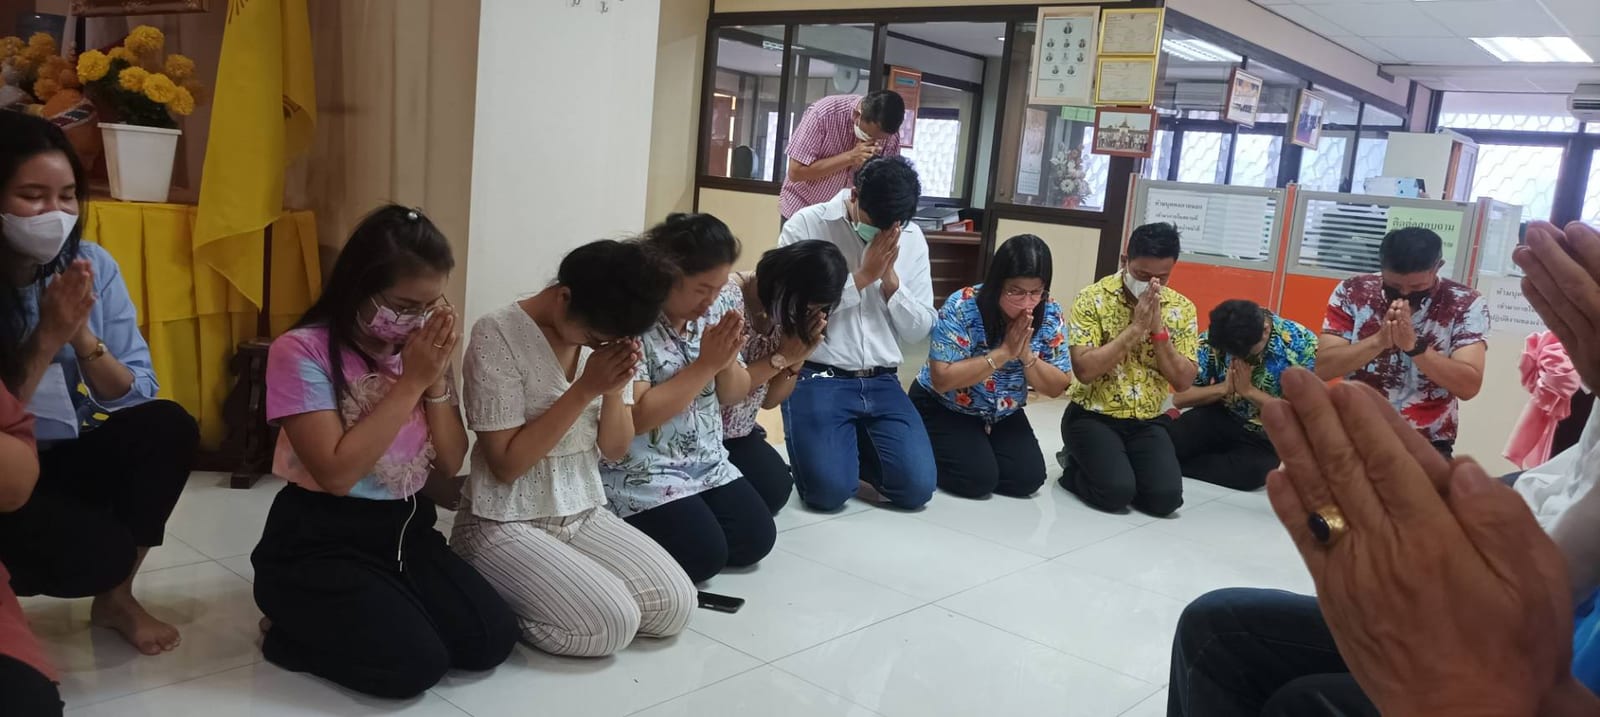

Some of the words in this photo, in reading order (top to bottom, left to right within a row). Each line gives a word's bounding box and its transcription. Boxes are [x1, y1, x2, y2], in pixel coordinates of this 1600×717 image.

[1392, 217, 1455, 231] ติดต่อสอบถาม
